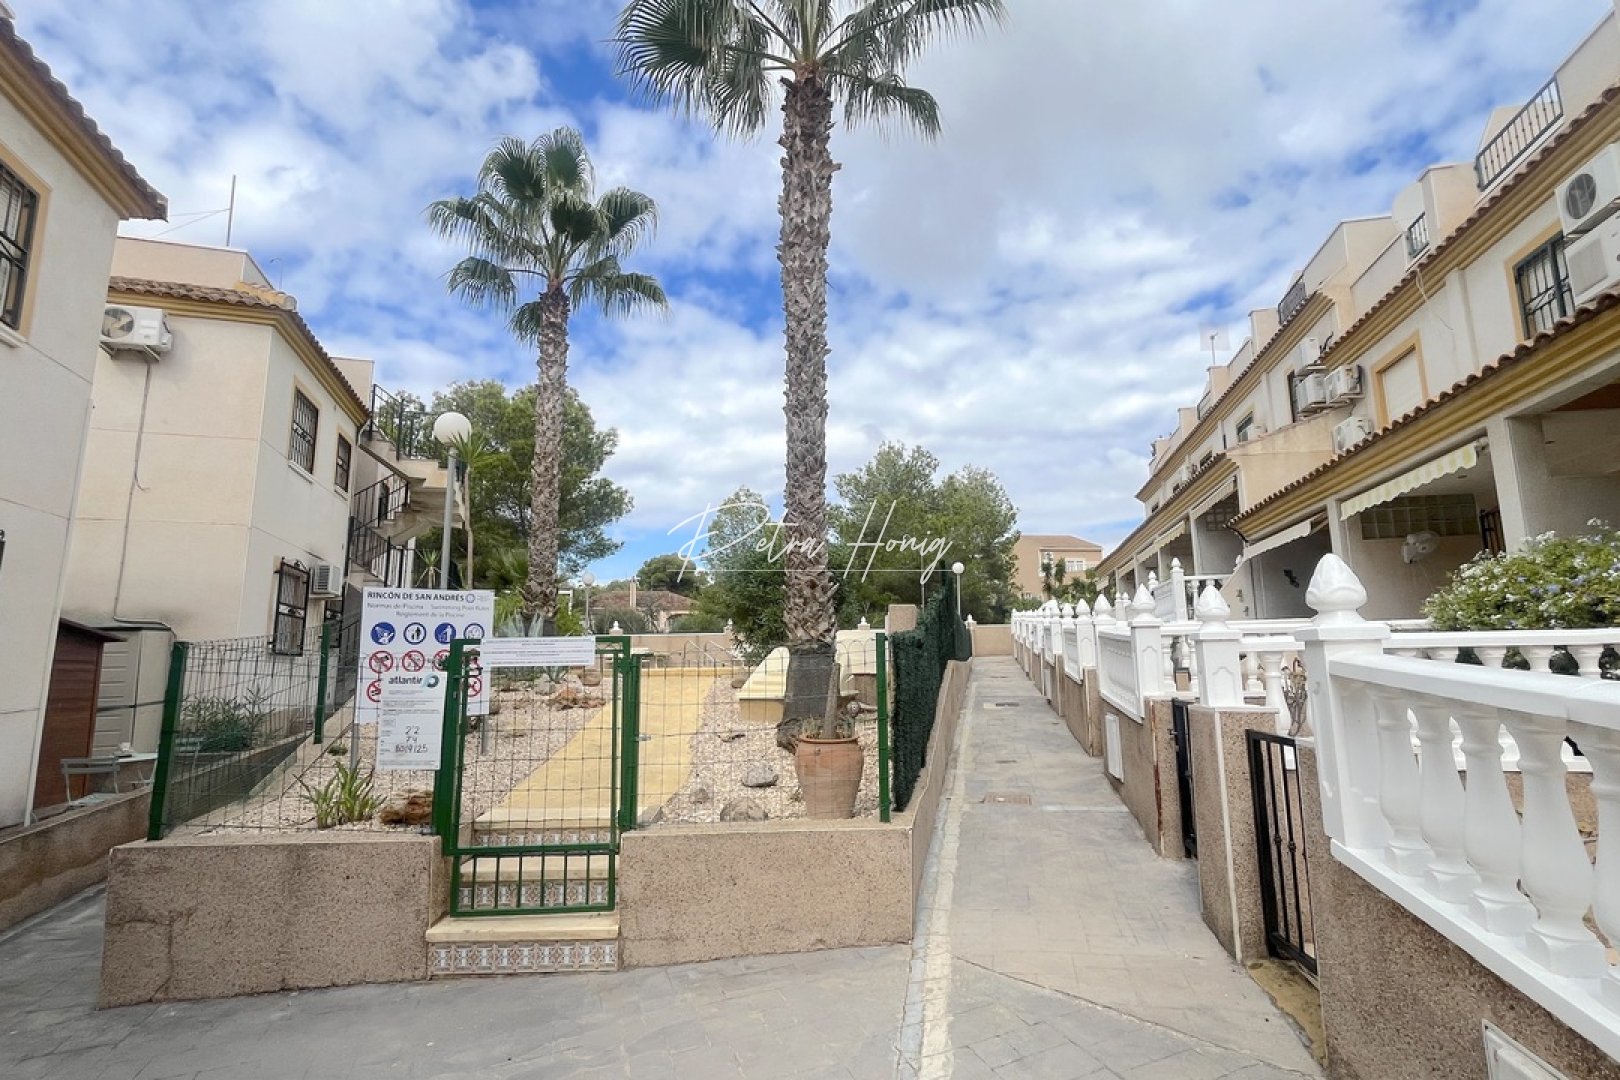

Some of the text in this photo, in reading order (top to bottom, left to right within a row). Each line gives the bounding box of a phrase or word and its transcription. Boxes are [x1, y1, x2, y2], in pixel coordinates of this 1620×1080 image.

[367, 591, 401, 600] RINCÓN
[402, 592, 413, 600] DE
[433, 593, 465, 602] ANDRÉS
